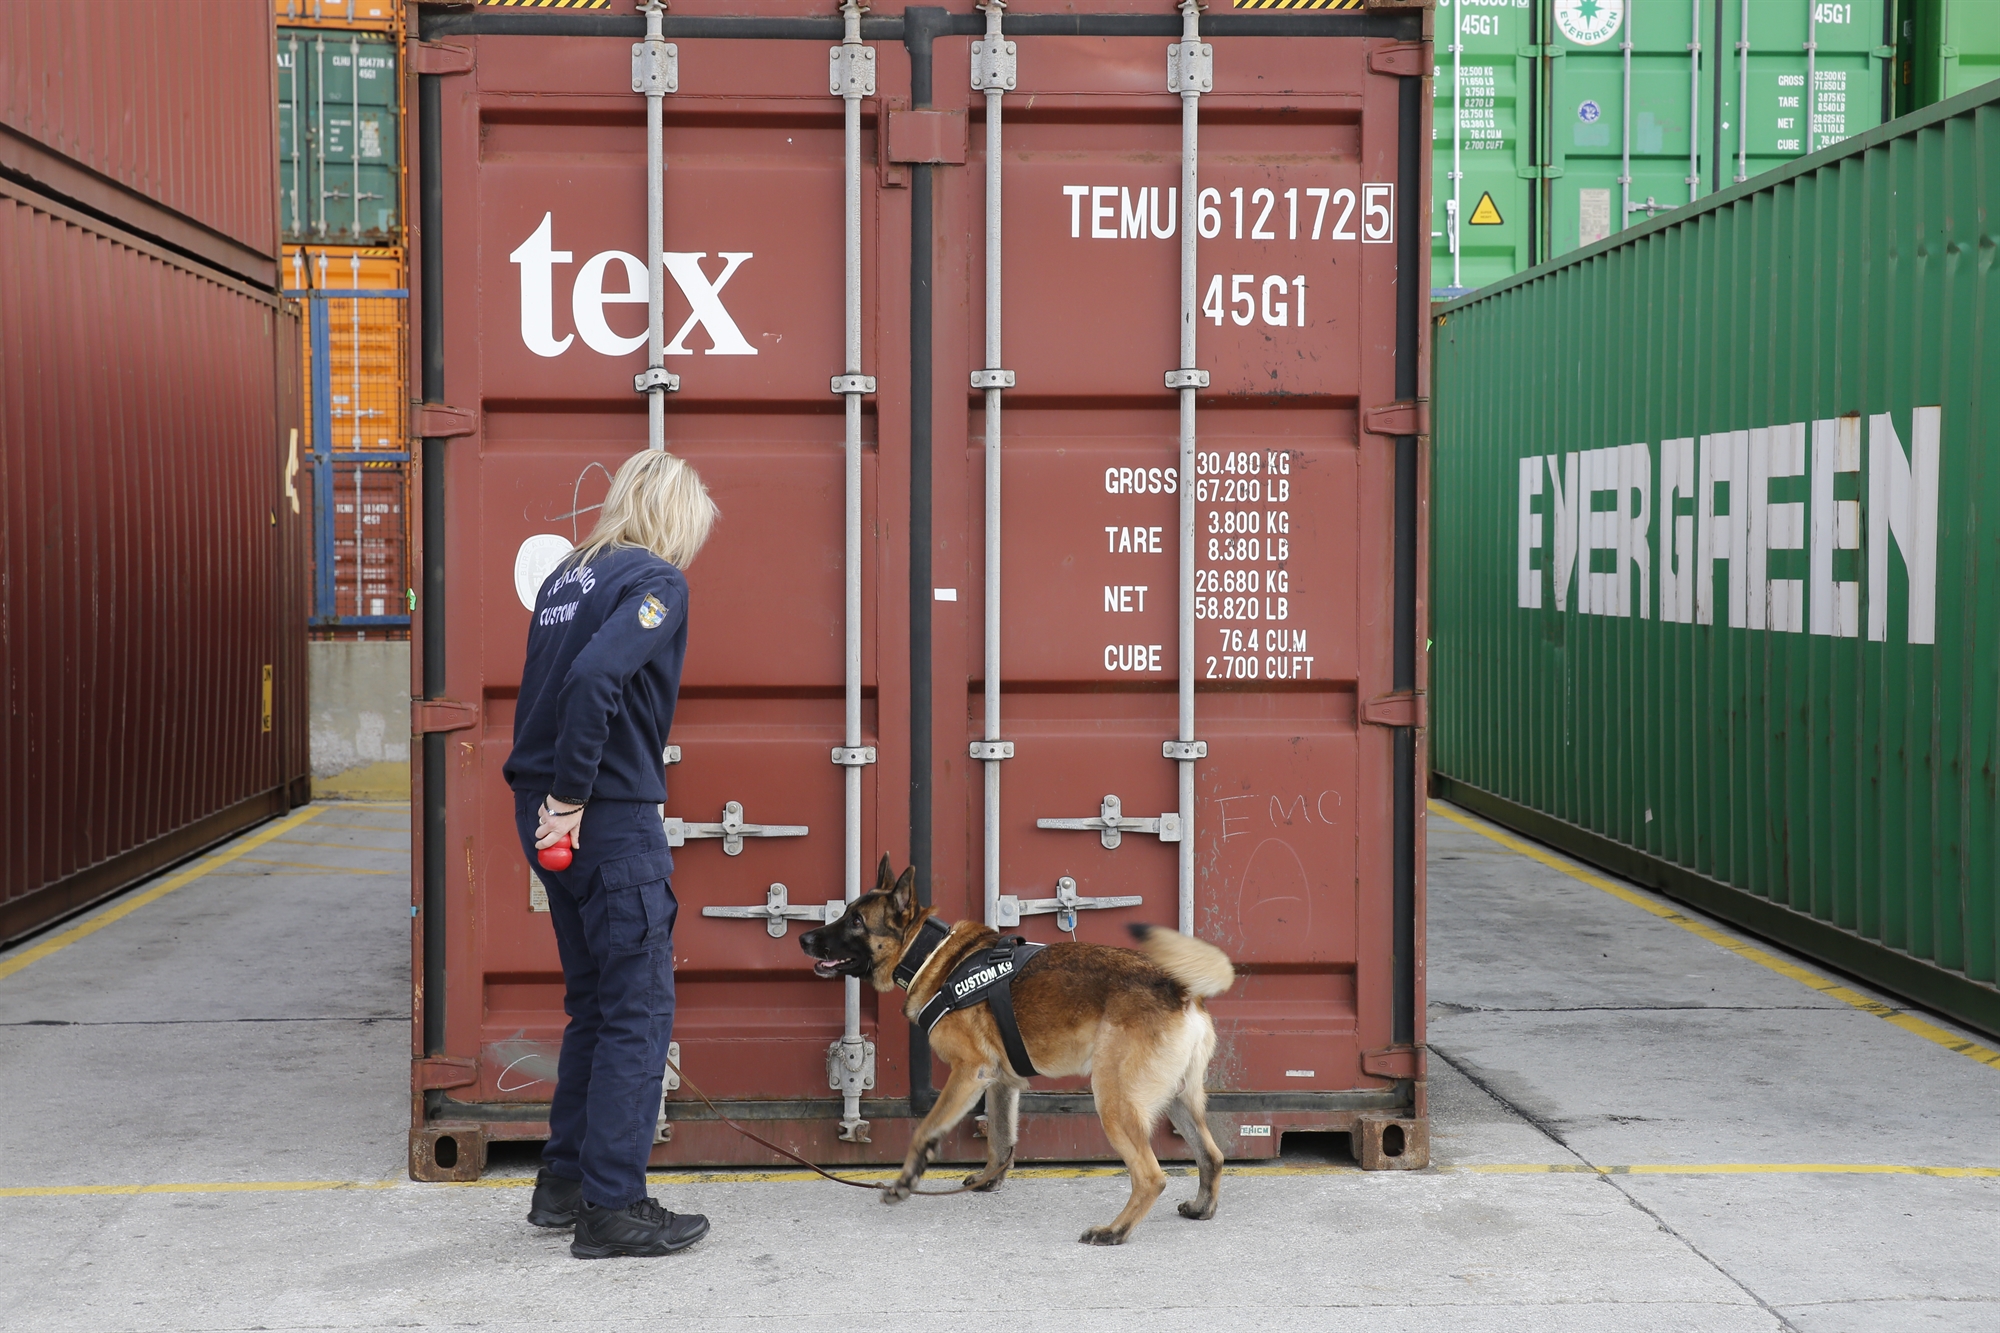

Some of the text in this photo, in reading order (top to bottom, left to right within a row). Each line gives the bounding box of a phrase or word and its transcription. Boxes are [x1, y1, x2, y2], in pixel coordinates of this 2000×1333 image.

[1815, 3, 1851, 24] 45G1
[1461, 14, 1499, 35] 45G1
[1560, 11, 1618, 41] EVERGREEN
[1460, 66, 1493, 76] 32.500 KG
[1485, 77, 1494, 86] LB
[1778, 75, 1804, 86] GROSS
[1837, 71, 1846, 81] KG
[1486, 87, 1495, 97] KG
[1837, 82, 1846, 91] LB
[1465, 98, 1494, 107] 8.270 LB
[1778, 97, 1799, 107] TARE
[1837, 93, 1845, 102] KG
[1837, 103, 1845, 112] LB
[1460, 109, 1494, 119] 28.750 KG
[1486, 120, 1495, 128] LB
[1777, 118, 1794, 129] NET
[1814, 114, 1845, 123] 28.625 KG
[1470, 130, 1502, 139] 76.4 CU.M
[1836, 124, 1844, 133] LB
[1486, 141, 1504, 150] CU.FT
[1777, 139, 1799, 150] CUBE
[1821, 135, 1836, 145] 76.4
[1063, 185, 1177, 240] TEMU
[510, 211, 759, 358] tex
[1202, 274, 1306, 327] 45G1
[1267, 452, 1290, 475] KG
[1104, 467, 1178, 494] GROSS
[1267, 479, 1290, 503] LB
[1266, 511, 1289, 534] KG
[1517, 405, 1942, 645] EVERGREEN
[1104, 526, 1163, 554] TARE
[1266, 538, 1289, 561] LB
[1266, 570, 1289, 594] KG
[1104, 586, 1148, 612] NET
[1266, 597, 1288, 621] LB
[1219, 629, 1307, 652] 76.4 CU.M
[1104, 645, 1162, 672] CUBE
[1266, 656, 1314, 679] CU.FT
[954, 961, 1013, 996] CUSTOM K9
